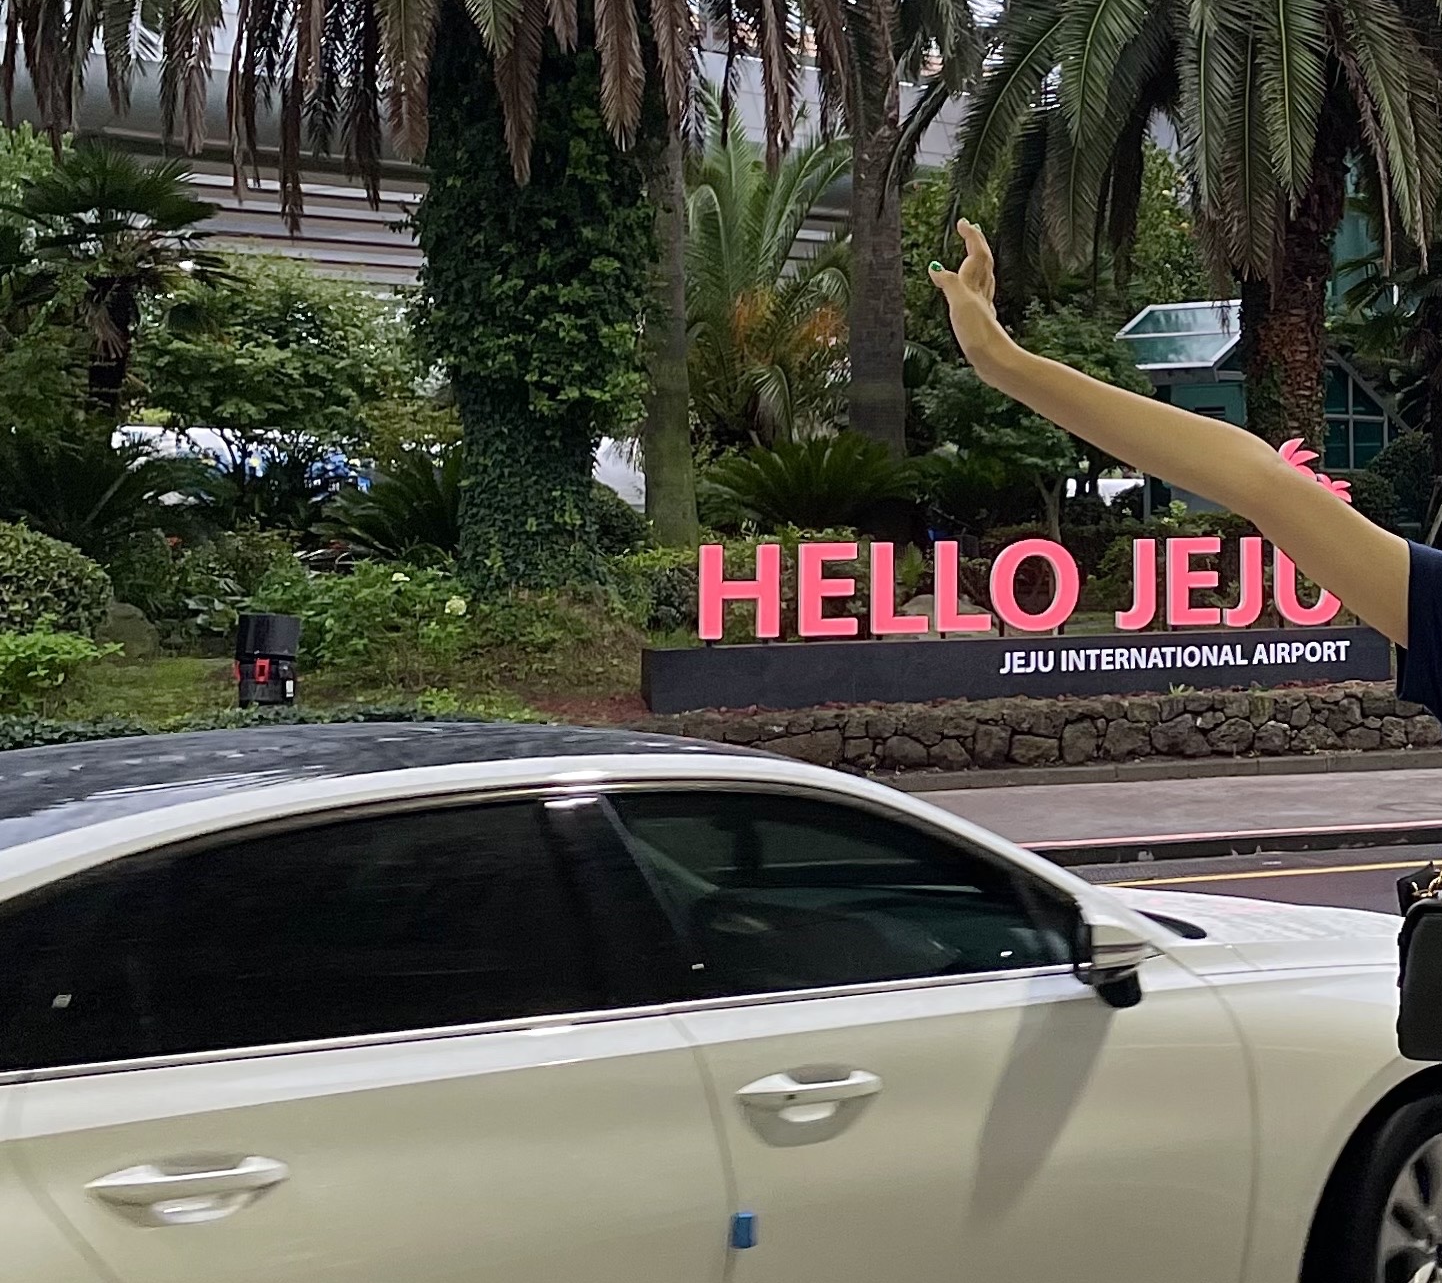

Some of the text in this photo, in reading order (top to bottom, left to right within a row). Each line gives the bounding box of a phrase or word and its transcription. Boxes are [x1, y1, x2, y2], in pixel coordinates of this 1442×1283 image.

[699, 536, 1343, 640] HELLO JEJU
[999, 640, 1351, 674] JEJU INTERNATIONAL AIRPORT
